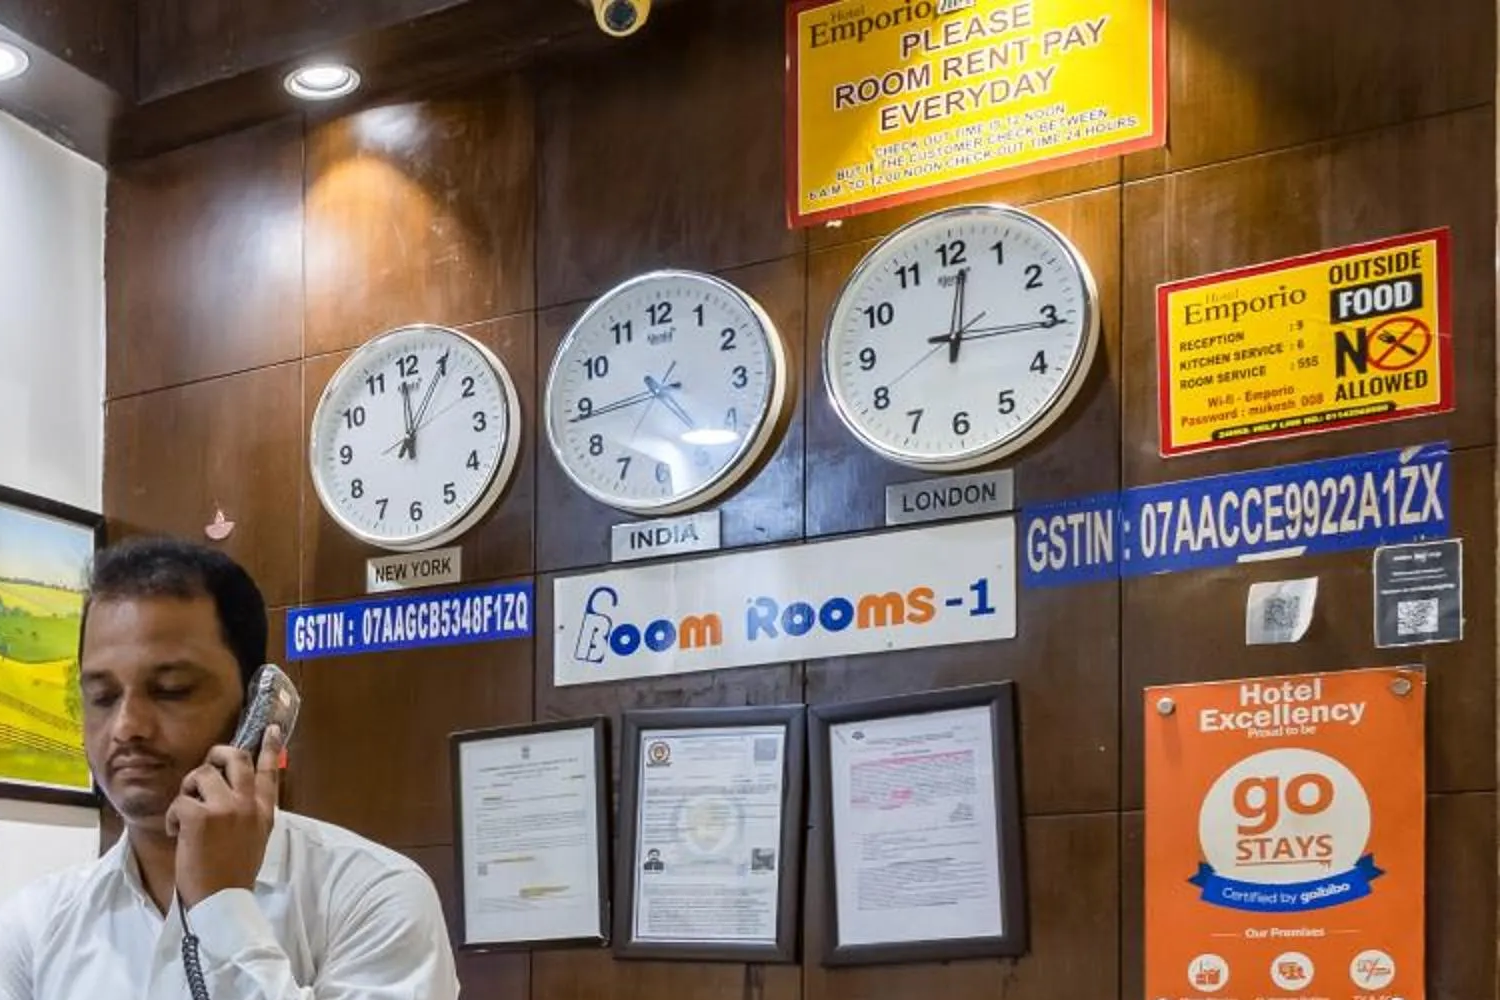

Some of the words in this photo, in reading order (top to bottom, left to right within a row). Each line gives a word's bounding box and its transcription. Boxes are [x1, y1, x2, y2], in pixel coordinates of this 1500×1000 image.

[809, 0, 932, 48] Emporio
[901, 4, 1032, 58] PLEASE
[834, 65, 931, 109] ROOM
[942, 38, 1033, 81] RENT
[1043, 18, 1107, 57] PAY
[880, 67, 1056, 132] EVERYDAY
[875, 141, 918, 157] CHECK
[924, 132, 950, 146] OUT
[955, 123, 983, 138] TIME
[1025, 104, 1065, 122] NOON
[836, 165, 862, 181] BUT
[881, 154, 905, 169] THE
[910, 137, 982, 164] CUSTOMER
[988, 127, 1034, 144] CHECK
[1039, 108, 1108, 133] BETWEEN
[904, 162, 941, 178] NOON
[1031, 133, 1061, 148] TIME
[1085, 116, 1138, 136] HOURS
[935, 239, 967, 267] 12
[990, 241, 1004, 265] 1
[894, 263, 921, 289] 11
[1024, 264, 1043, 289] 2
[1329, 249, 1423, 285] OUTSIDE
[1184, 285, 1307, 326] Emporio
[1338, 280, 1414, 318] FOOD
[645, 302, 673, 327] 12
[692, 304, 704, 327] 1
[863, 302, 894, 328] 10
[1040, 305, 1059, 328] 3
[610, 320, 633, 346] 11
[720, 327, 736, 351] 2
[1179, 331, 1245, 352] RECEPTION
[395, 354, 419, 378] 12
[583, 355, 609, 381] 10
[859, 347, 877, 371] 9
[1029, 351, 1048, 375] 4
[1179, 351, 1231, 371] KITCHEN
[1233, 341, 1284, 362] SERVICE
[366, 372, 385, 396] 11
[461, 376, 476, 399] 2
[732, 365, 748, 389] 3
[1179, 374, 1214, 390] ROOM
[1217, 366, 1266, 384] SERVICE
[1334, 369, 1428, 401] ALLOWED
[873, 386, 891, 410] 8
[997, 390, 1016, 415] 5
[1245, 386, 1295, 404] Emporio
[342, 406, 366, 430] 10
[577, 397, 593, 419] 9
[1180, 409, 1238, 428] Password
[472, 411, 487, 434] 3
[907, 409, 924, 434] 7
[953, 412, 971, 435] 6
[339, 445, 353, 466] 9
[589, 434, 604, 457] 8
[465, 449, 480, 471] 4
[616, 457, 631, 481] 7
[350, 479, 364, 500] 8
[443, 482, 457, 506] 5
[902, 482, 997, 513] LONDON
[375, 498, 389, 520] 7
[409, 501, 423, 522] 6
[1027, 508, 1114, 574] GSTIN
[1139, 461, 1445, 559] 07AACCE9922A1ZX
[630, 523, 699, 550] INDIA
[375, 563, 408, 583] NEW
[411, 557, 452, 578] YORK
[294, 613, 344, 652] GSTIN
[362, 591, 529, 645] 07AAGCB5348F1ZQ
[573, 586, 723, 664] Boom
[1239, 677, 1322, 706] Hotel
[1199, 701, 1367, 733] Excellency
[1232, 772, 1335, 836] go
[1235, 835, 1334, 861] STAYS
[1222, 886, 1278, 904] Certified
[1280, 890, 1297, 905] by
[1300, 882, 1351, 904] goibibo
